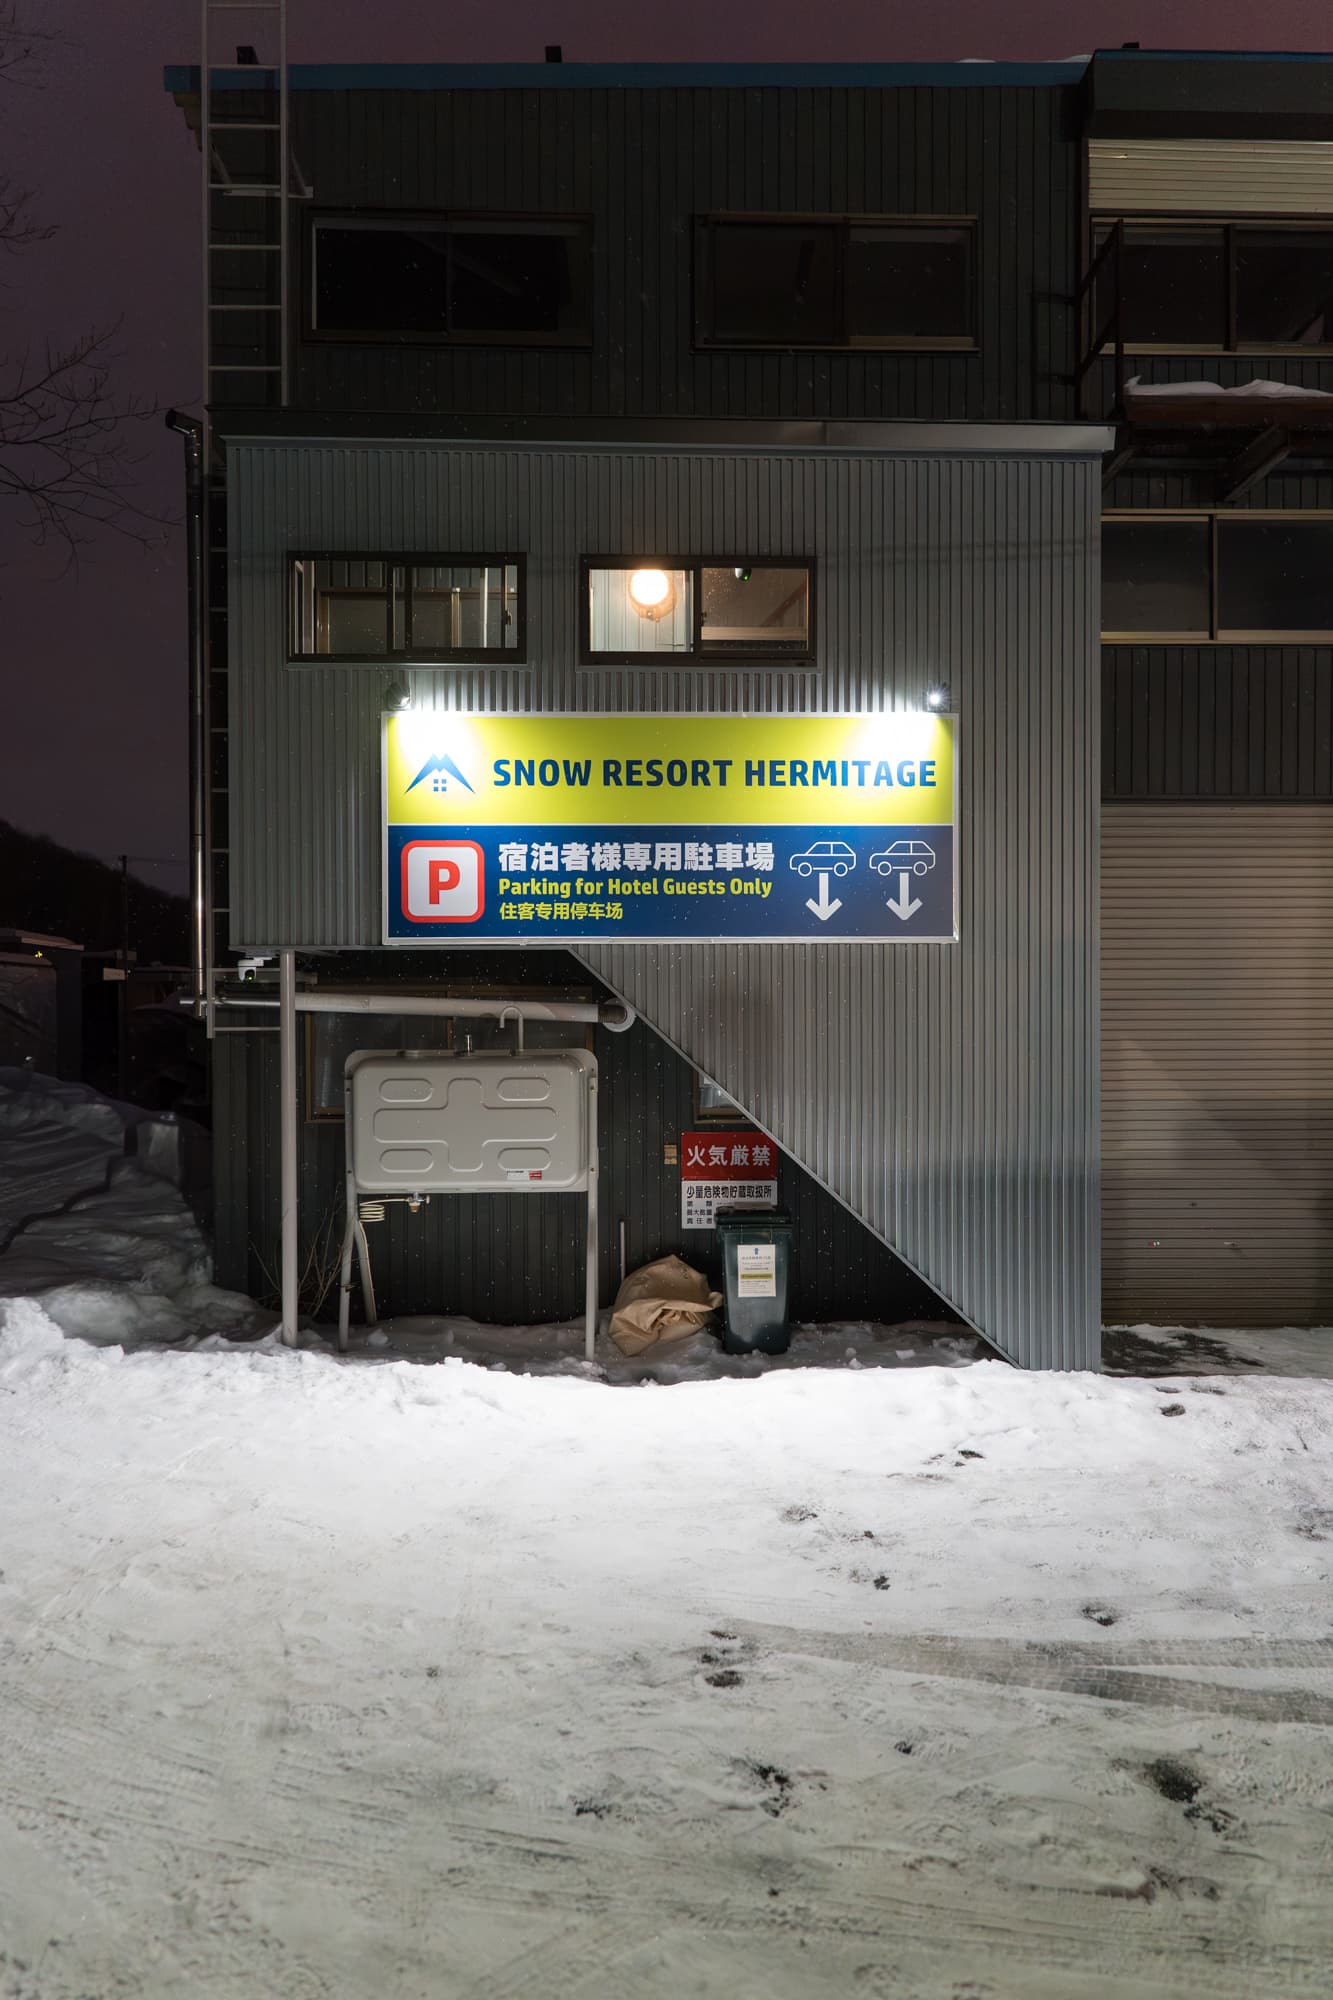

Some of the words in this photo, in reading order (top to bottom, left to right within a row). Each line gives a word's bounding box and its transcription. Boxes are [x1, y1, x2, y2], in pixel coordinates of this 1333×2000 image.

[493, 759, 592, 787] SNOW
[602, 759, 733, 787] RESORT
[745, 759, 937, 787] HERMITAGE
[498, 842, 775, 872] 宿泊者様専用駐車場
[428, 860, 461, 905] P
[499, 877, 571, 898] Parking
[575, 877, 604, 895] for
[608, 877, 659, 895] Hotel
[663, 878, 726, 895] Guests
[729, 877, 773, 898] Only
[499, 901, 623, 920] 住客专用停车场
[686, 1144, 771, 1167] 火気厳禁
[686, 1185, 772, 1199] 少量危険物貯蔵取扱所
